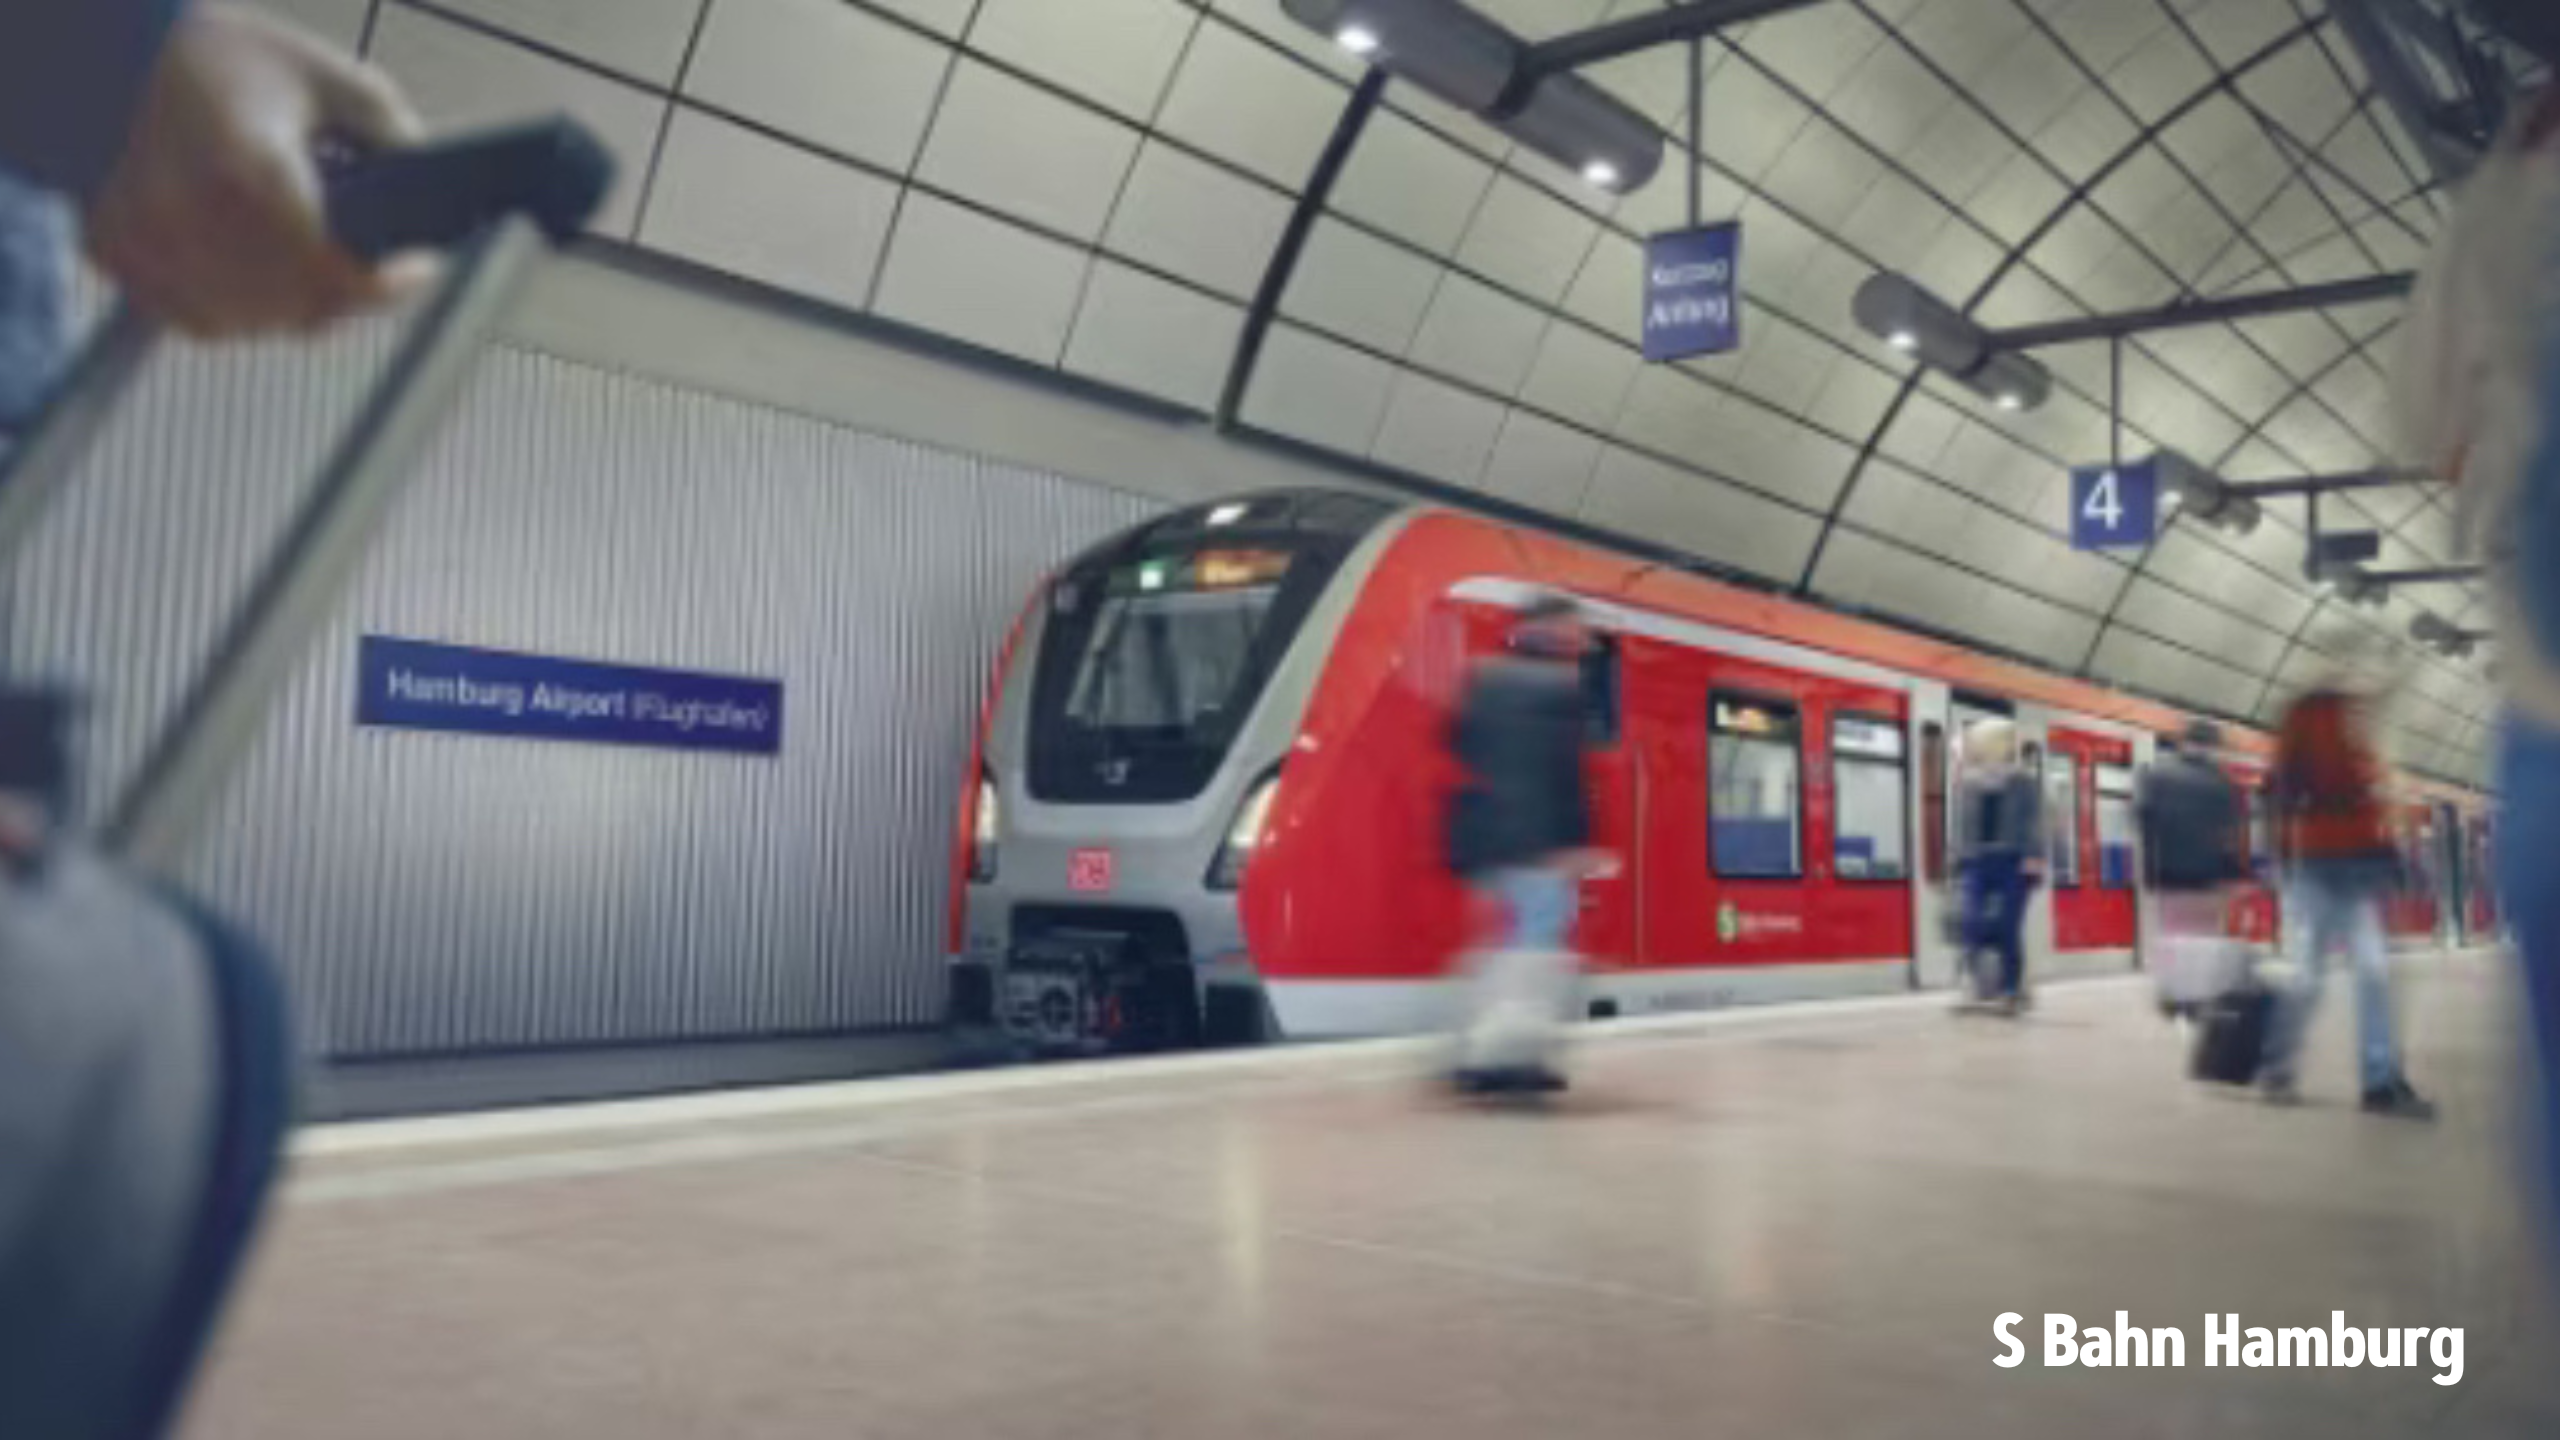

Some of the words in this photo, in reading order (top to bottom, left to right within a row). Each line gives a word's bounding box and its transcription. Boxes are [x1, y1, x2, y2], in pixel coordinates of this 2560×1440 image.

[2081, 470, 2124, 530] 4
[387, 667, 524, 717] Hamburg
[528, 681, 626, 721] Airport
